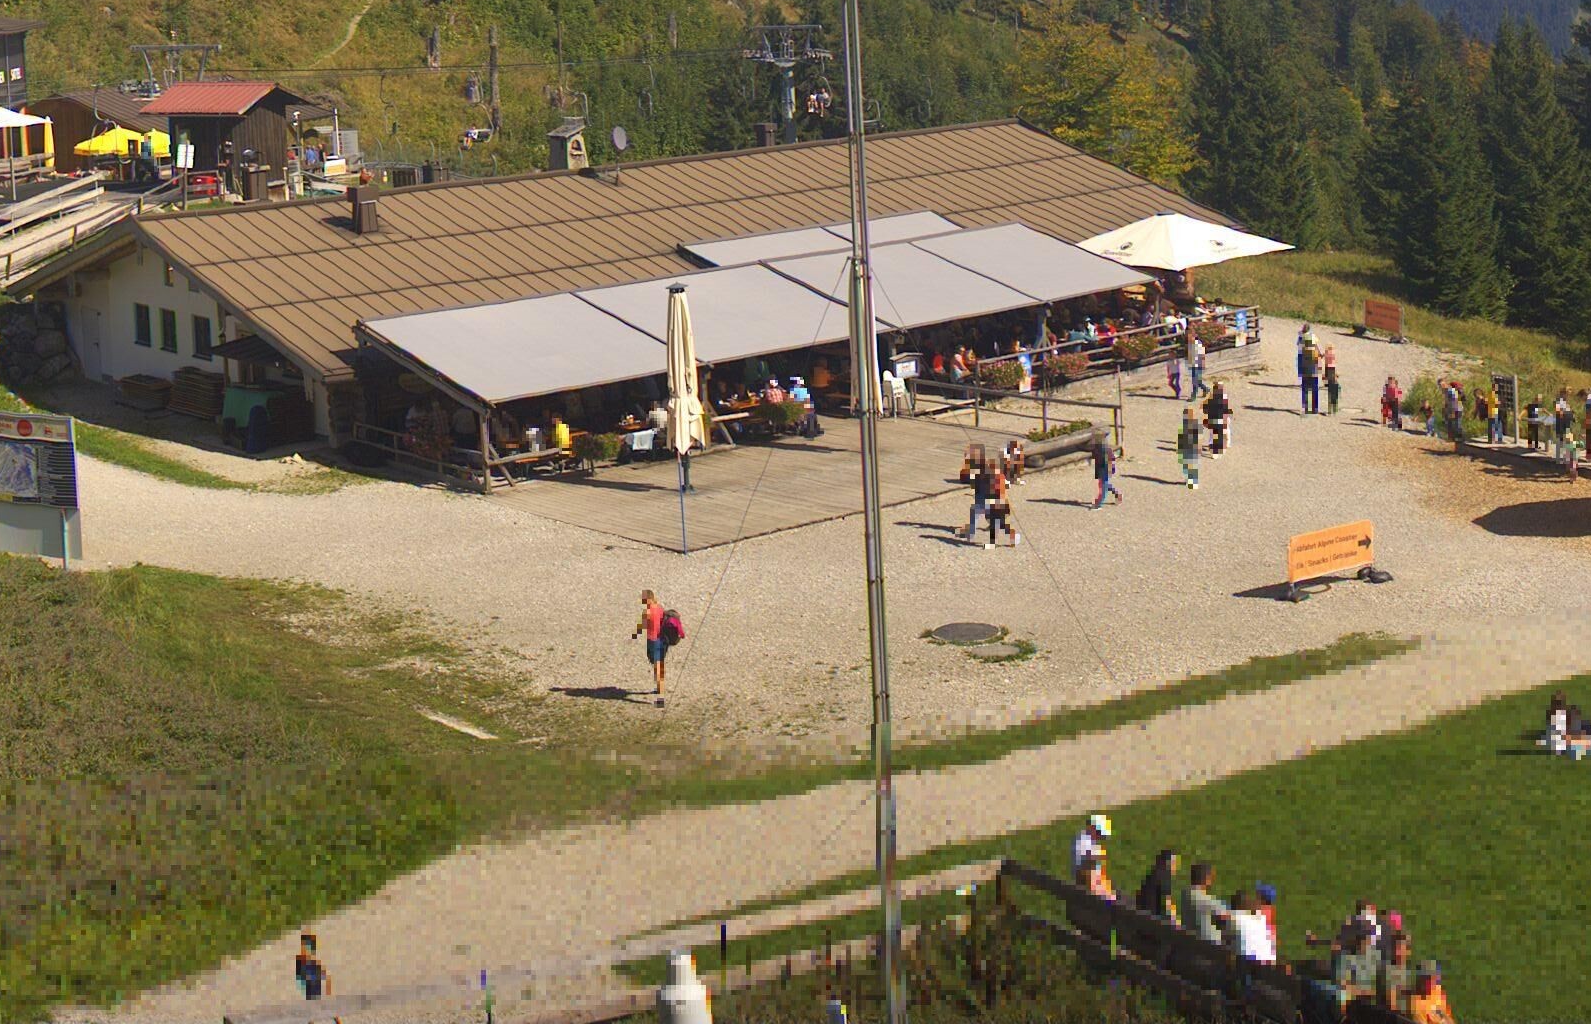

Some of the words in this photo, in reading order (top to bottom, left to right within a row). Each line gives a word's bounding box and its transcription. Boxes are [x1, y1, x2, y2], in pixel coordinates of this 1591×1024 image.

[1318, 538, 1334, 548] Alpine
[1335, 534, 1357, 543] Coaster
[1308, 556, 1328, 566] Snacks
